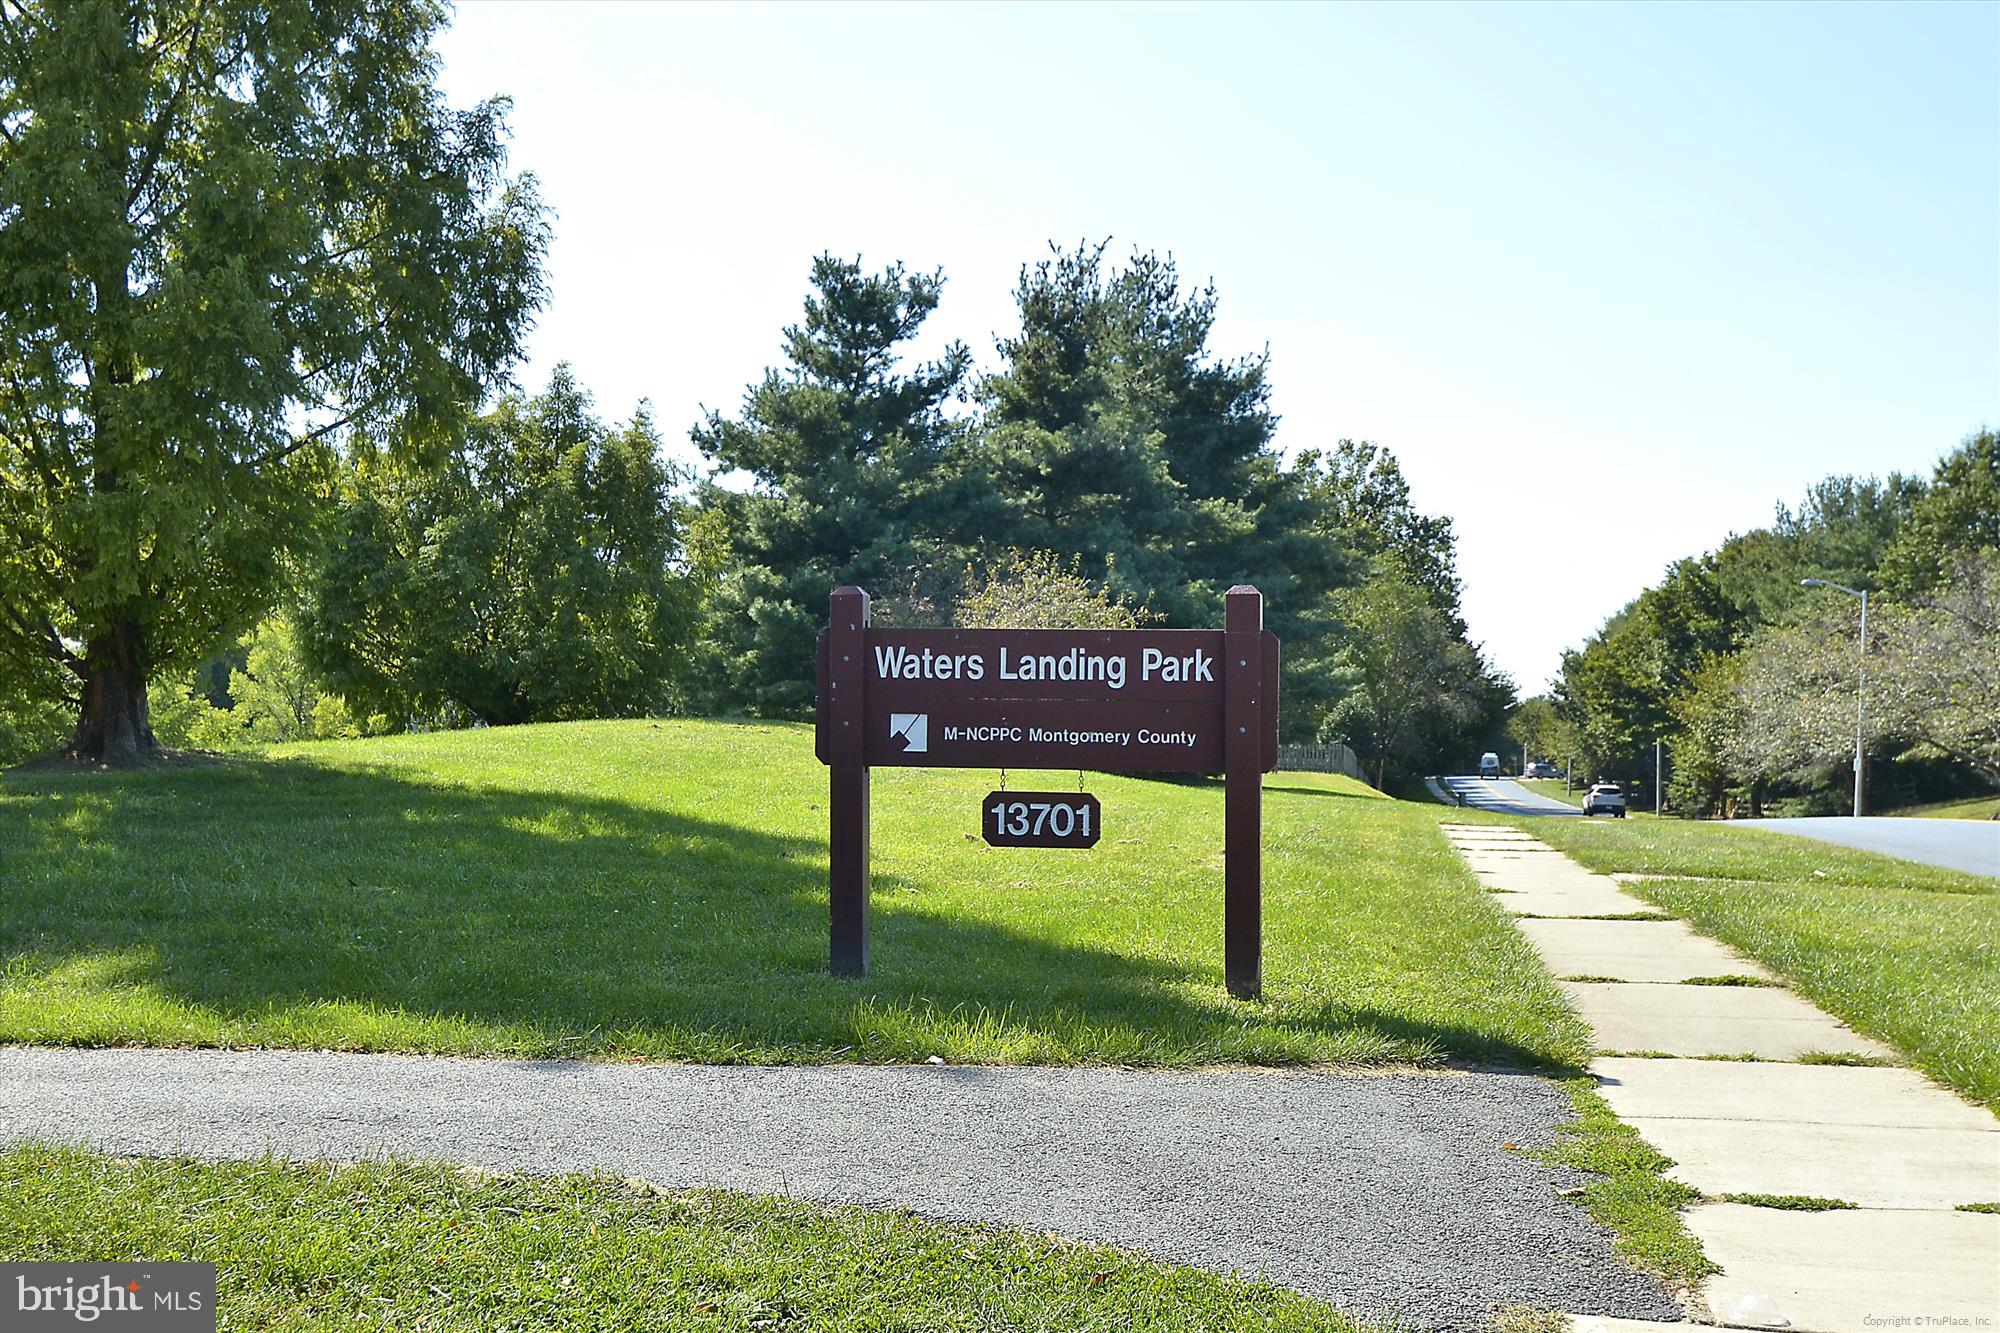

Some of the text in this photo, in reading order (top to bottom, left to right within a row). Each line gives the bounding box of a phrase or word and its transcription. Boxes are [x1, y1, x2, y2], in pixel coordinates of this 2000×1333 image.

[875, 646, 1214, 689] Waters Landing Park
[944, 726, 1197, 747] M-NCPPC Montgomery County
[991, 803, 1091, 837] 13701
